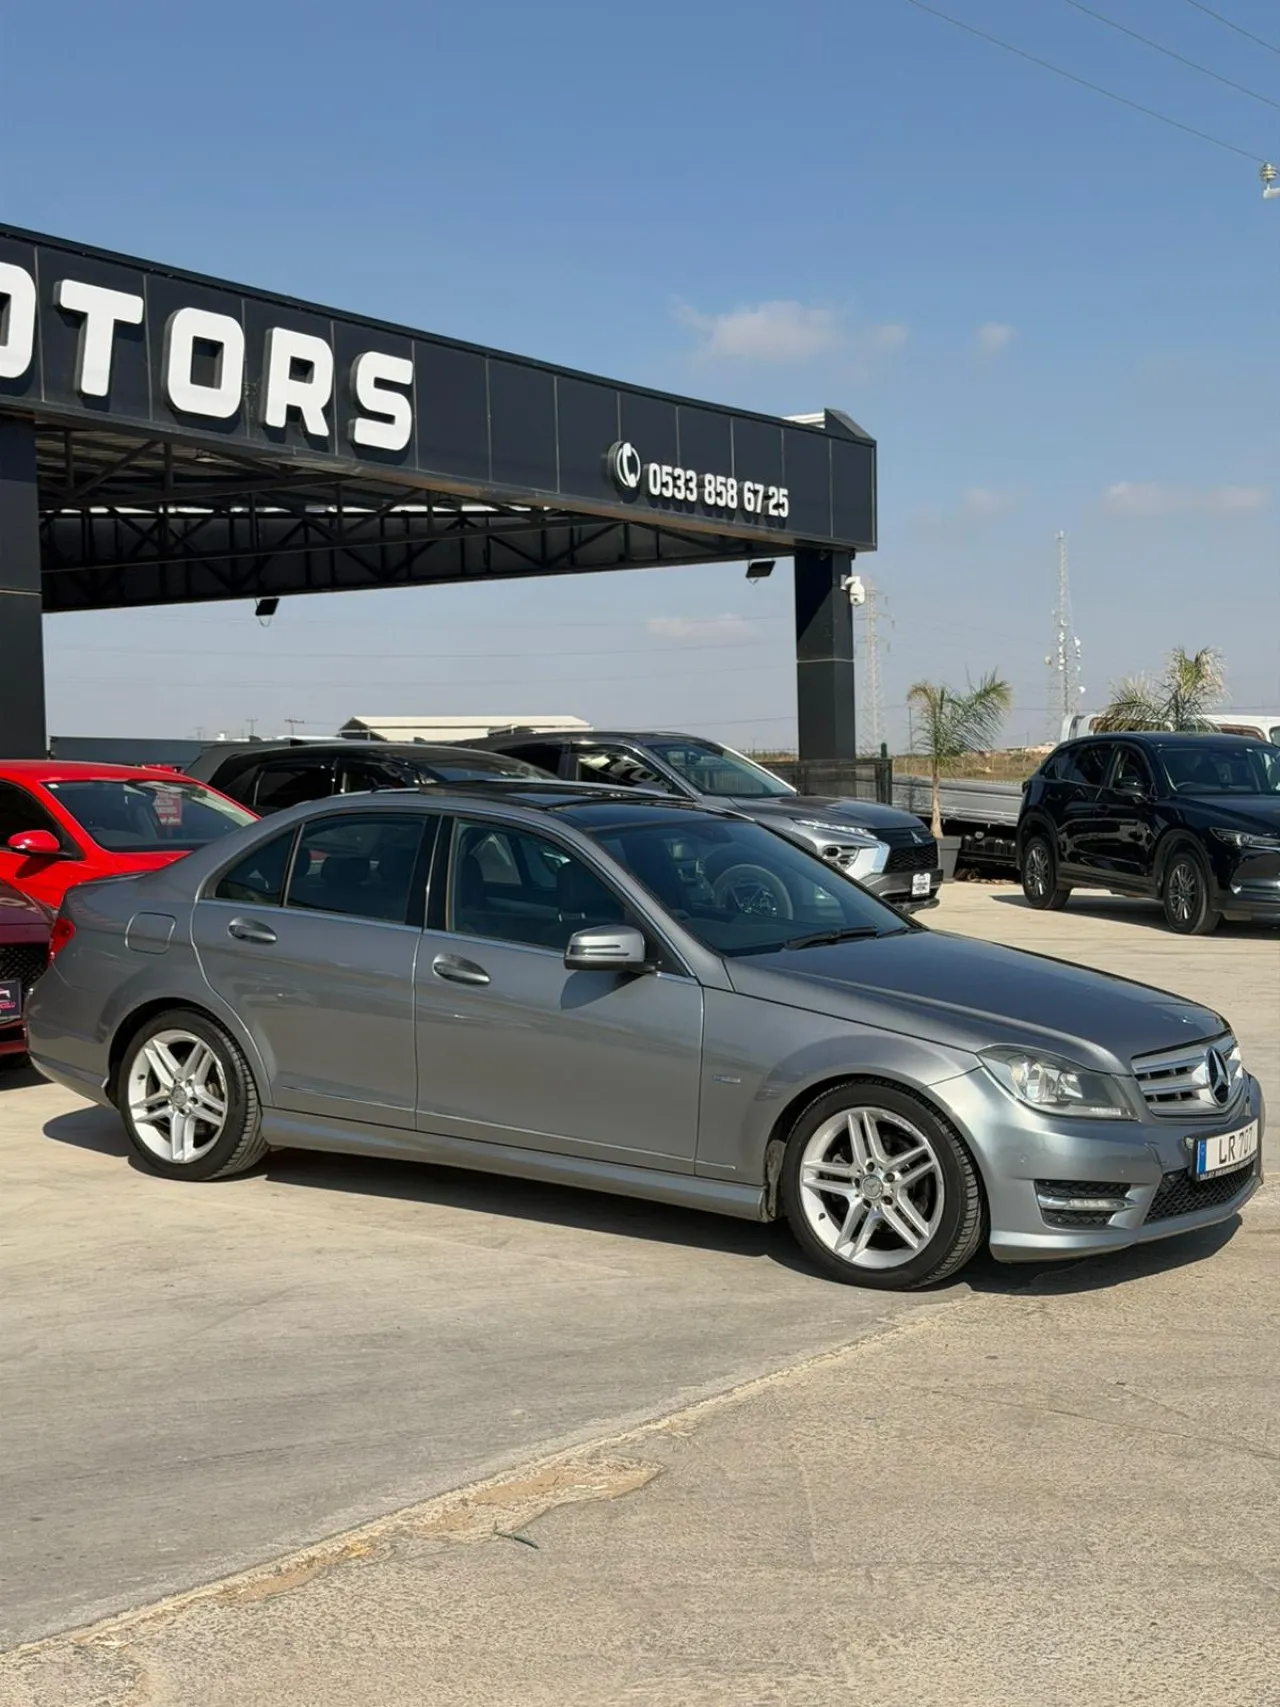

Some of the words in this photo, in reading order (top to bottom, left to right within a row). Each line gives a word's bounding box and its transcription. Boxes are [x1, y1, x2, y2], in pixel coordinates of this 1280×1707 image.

[648, 462, 698, 502] 0533
[704, 473, 738, 509] 858
[1219, 1135, 1236, 1164] LR
